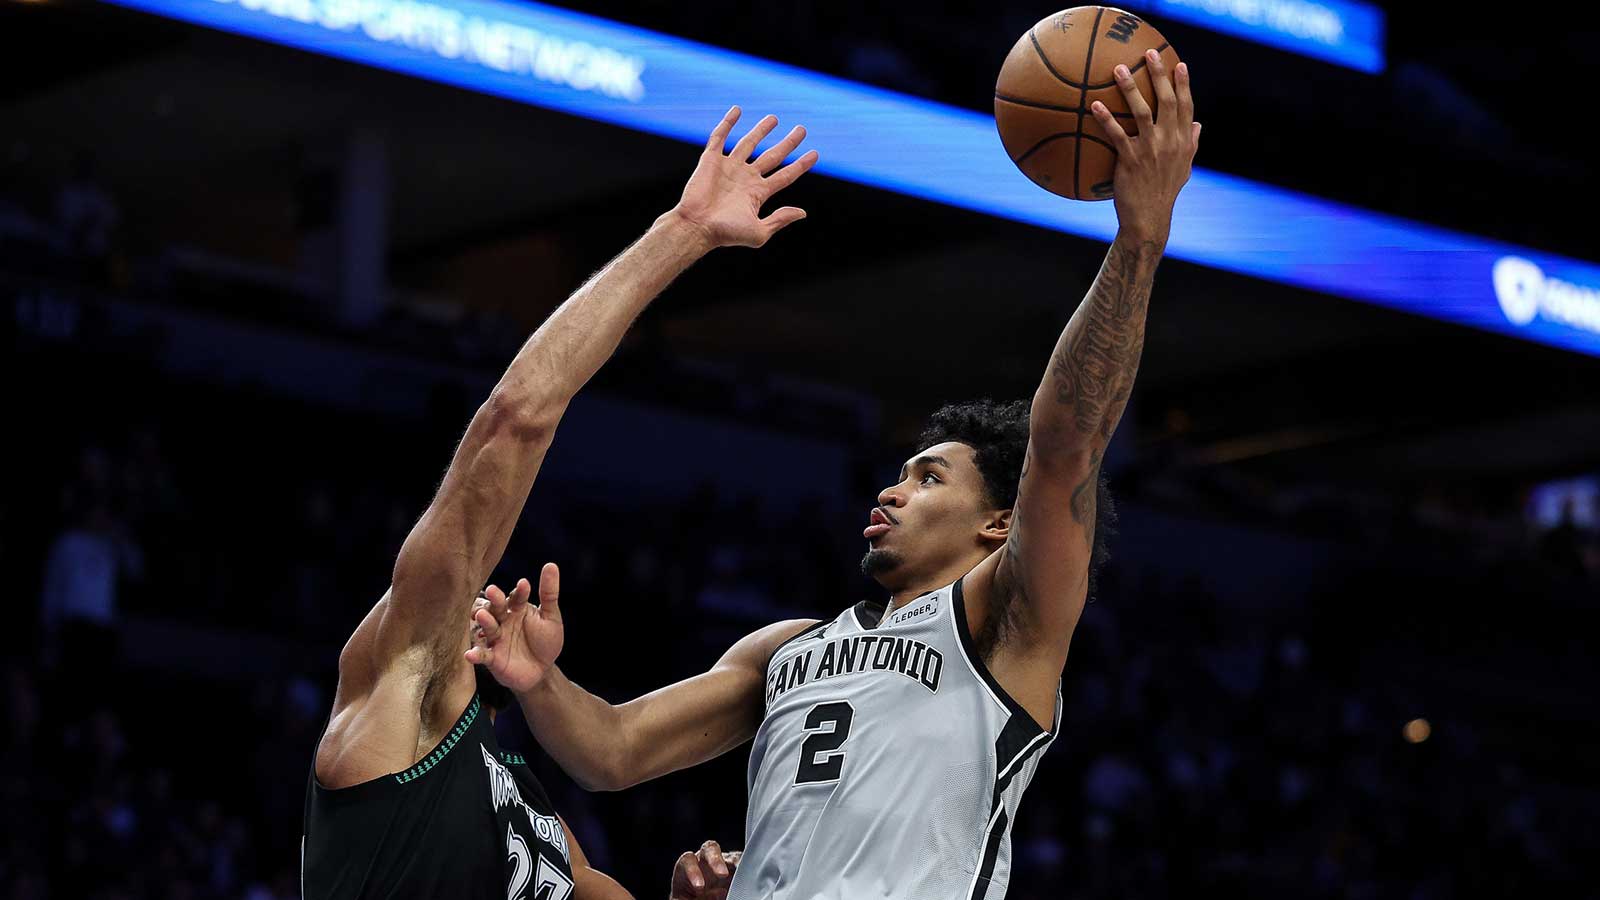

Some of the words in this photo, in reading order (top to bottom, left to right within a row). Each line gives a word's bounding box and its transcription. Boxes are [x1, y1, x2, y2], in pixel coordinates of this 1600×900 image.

[894, 602, 932, 625] LEDGER
[812, 635, 945, 696] ANTONIO
[793, 699, 856, 787] 2
